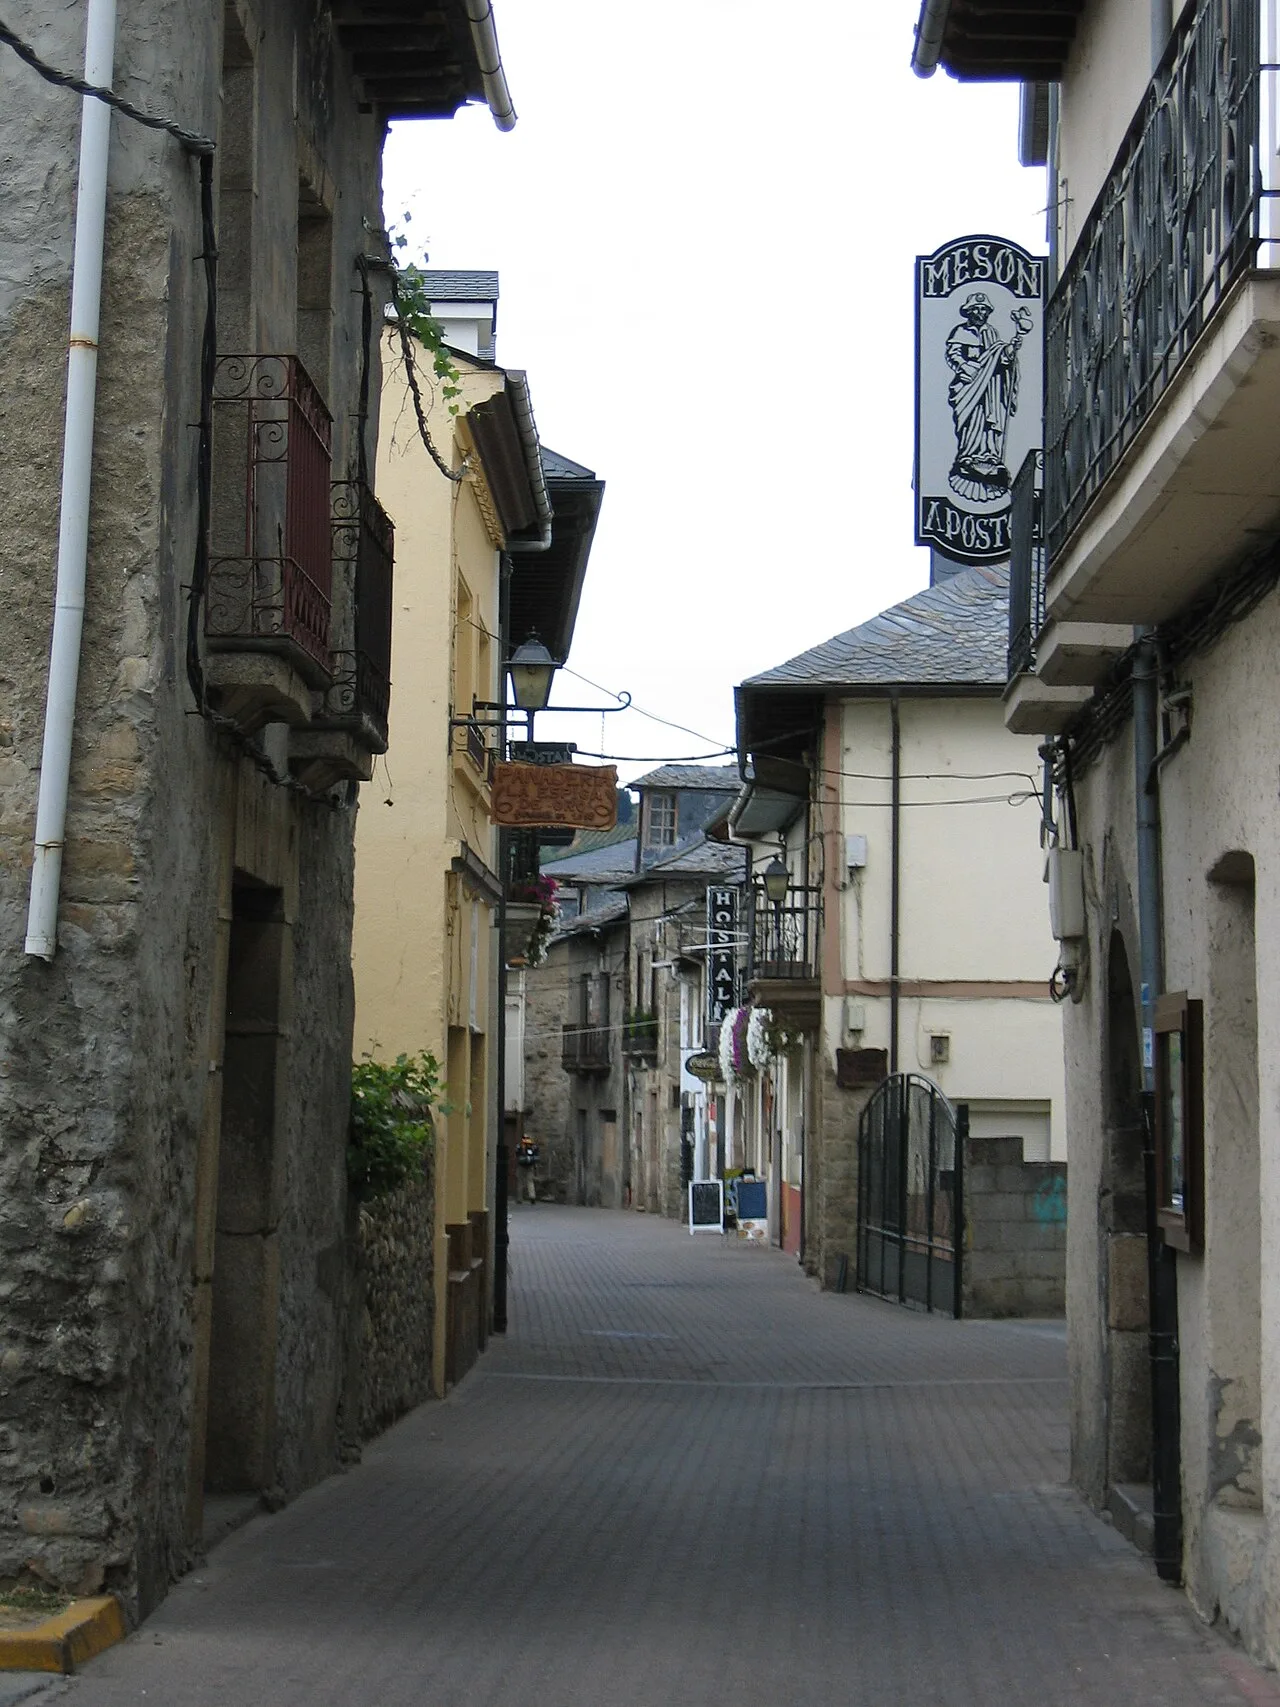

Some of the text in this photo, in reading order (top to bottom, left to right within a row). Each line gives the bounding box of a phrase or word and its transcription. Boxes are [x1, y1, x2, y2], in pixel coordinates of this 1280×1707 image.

[507, 784, 603, 801] LA ESPIGA
[519, 799, 586, 813] DE ORO
[714, 892, 732, 1001] HOSTAL
